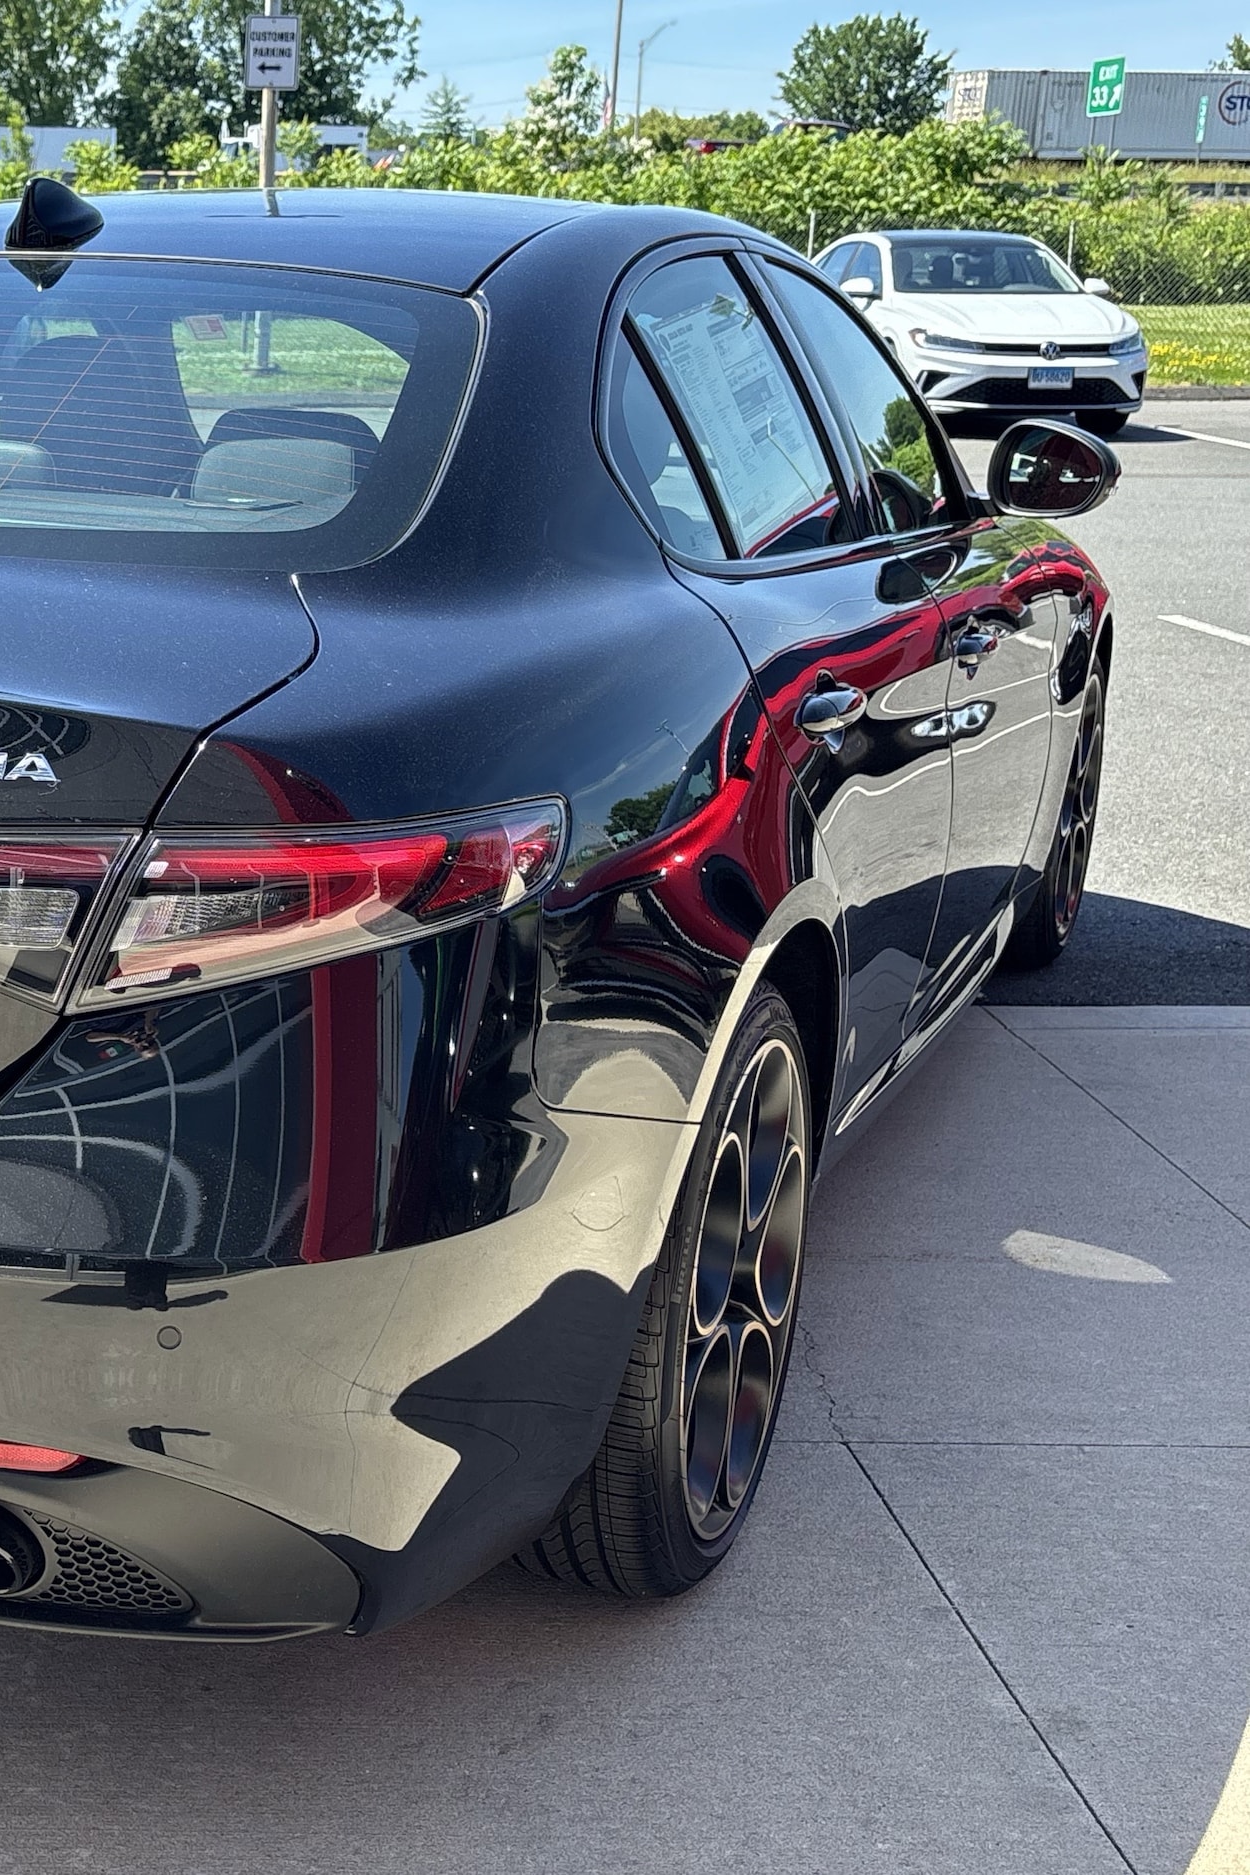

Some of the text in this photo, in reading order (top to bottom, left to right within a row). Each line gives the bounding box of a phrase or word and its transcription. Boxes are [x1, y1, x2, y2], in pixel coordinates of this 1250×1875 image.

[250, 32, 295, 42] CUSTOMER
[253, 47, 292, 57] PARKING
[1099, 65, 1119, 81] EXIT
[1091, 85, 1108, 107] 33
